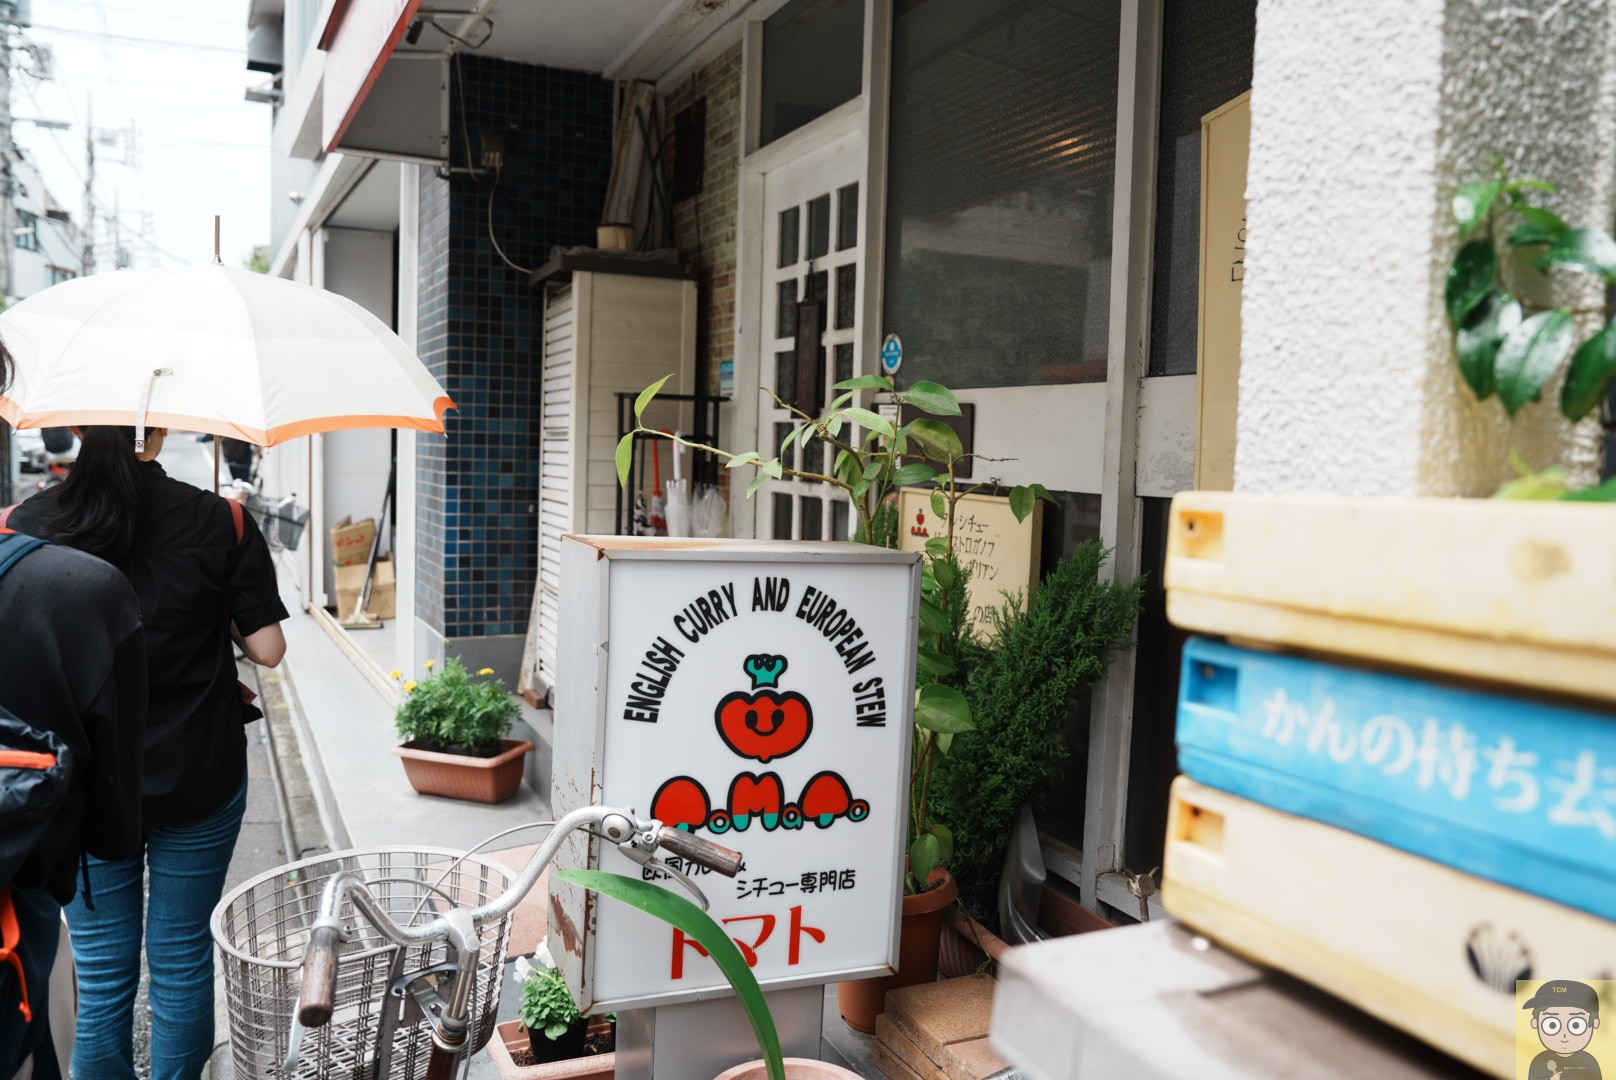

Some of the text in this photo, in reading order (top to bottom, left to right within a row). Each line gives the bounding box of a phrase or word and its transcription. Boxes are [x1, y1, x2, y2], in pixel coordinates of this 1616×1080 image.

[623, 577, 886, 727] ENGLISH CURRY AND EUROPEAN STEW
[736, 868, 856, 899] シチュー専門店
[671, 905, 826, 980] トマト
